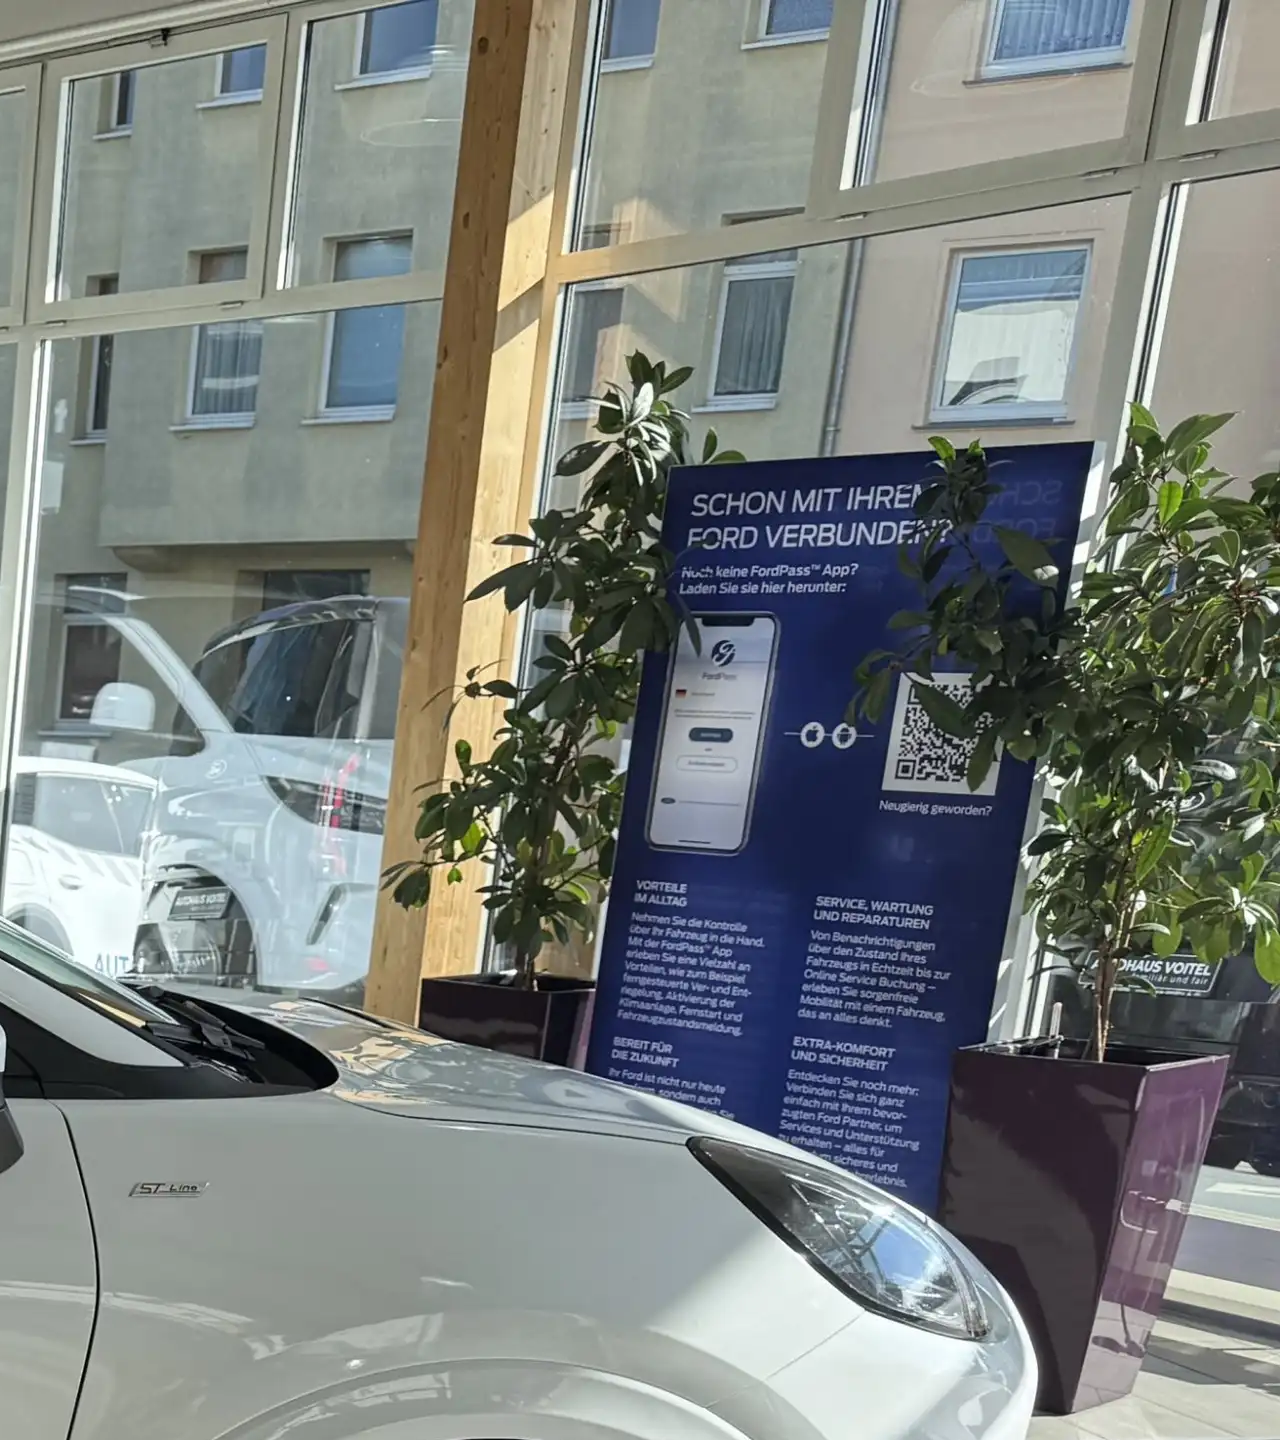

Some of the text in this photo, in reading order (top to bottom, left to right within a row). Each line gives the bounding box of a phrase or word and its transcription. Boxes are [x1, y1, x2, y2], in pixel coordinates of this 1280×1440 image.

[691, 489, 786, 516] SCHON
[792, 488, 842, 513] MIT
[688, 526, 758, 550] FORD
[715, 564, 749, 578] keine
[822, 563, 859, 578] App?
[679, 581, 847, 595] Laden Sie sie hier herunter:
[879, 800, 993, 816] Neugierig geworden?
[636, 880, 688, 894] VORTEILE
[634, 893, 688, 908] IM ALLTAG
[815, 896, 934, 916] SERVICE, WARTUNG
[631, 912, 748, 933] Nehmen Sie die Kontrolle
[813, 910, 930, 930] UND REPARATUREN
[627, 936, 643, 947] Mit
[644, 937, 660, 949] der
[712, 945, 733, 958] App
[629, 924, 765, 948] über Ihr Fahrzeug in die Hand.
[810, 930, 936, 951] Von Benachrichtigungen
[626, 949, 751, 972] erleben Sie eine Vielzahl an
[808, 942, 927, 964] über den Zustand Ihres
[806, 956, 951, 981] Fahrzeugs in Echtzeit bis zur
[1165, 961, 1212, 976] VOITEL
[804, 969, 837, 982] Online
[839, 972, 877, 986] Service
[878, 977, 926, 993] Buchung
[802, 983, 919, 1004] erleben Sie sorgenfreie
[798, 1008, 893, 1028] das an alles denkt.
[800, 995, 946, 1023] Mobilität mit einem Fahrzeug,
[616, 1009, 743, 1037] Fahrzeugzustandsmeldung.
[613, 1036, 673, 1054] BEREIT FÜR
[793, 1036, 896, 1059] EXTRA-KOMFORT
[611, 1048, 680, 1068] DIE ZUKUNFT
[791, 1050, 889, 1072] UND SICHERHEIT
[608, 1067, 621, 1078] Ihr
[622, 1068, 643, 1081] Ford
[644, 1072, 656, 1083] ist
[657, 1075, 680, 1088] nicht
[681, 1079, 697, 1090] nur
[698, 1081, 726, 1095] heute
[787, 1069, 920, 1096] Entdecken Sie noch mehr:
[786, 1081, 905, 1109] Verbinden Sie sich ganz
[783, 1095, 907, 1120] einfach mit Ihrem bevor-
[781, 1108, 903, 1134] zugten Ford Partner, um
[779, 1120, 920, 1151] Services und Unterstützung
[791, 1134, 832, 1149] erhalten
[842, 1143, 868, 1156] alles
[869, 1145, 886, 1157] für
[876, 1162, 898, 1173] und
